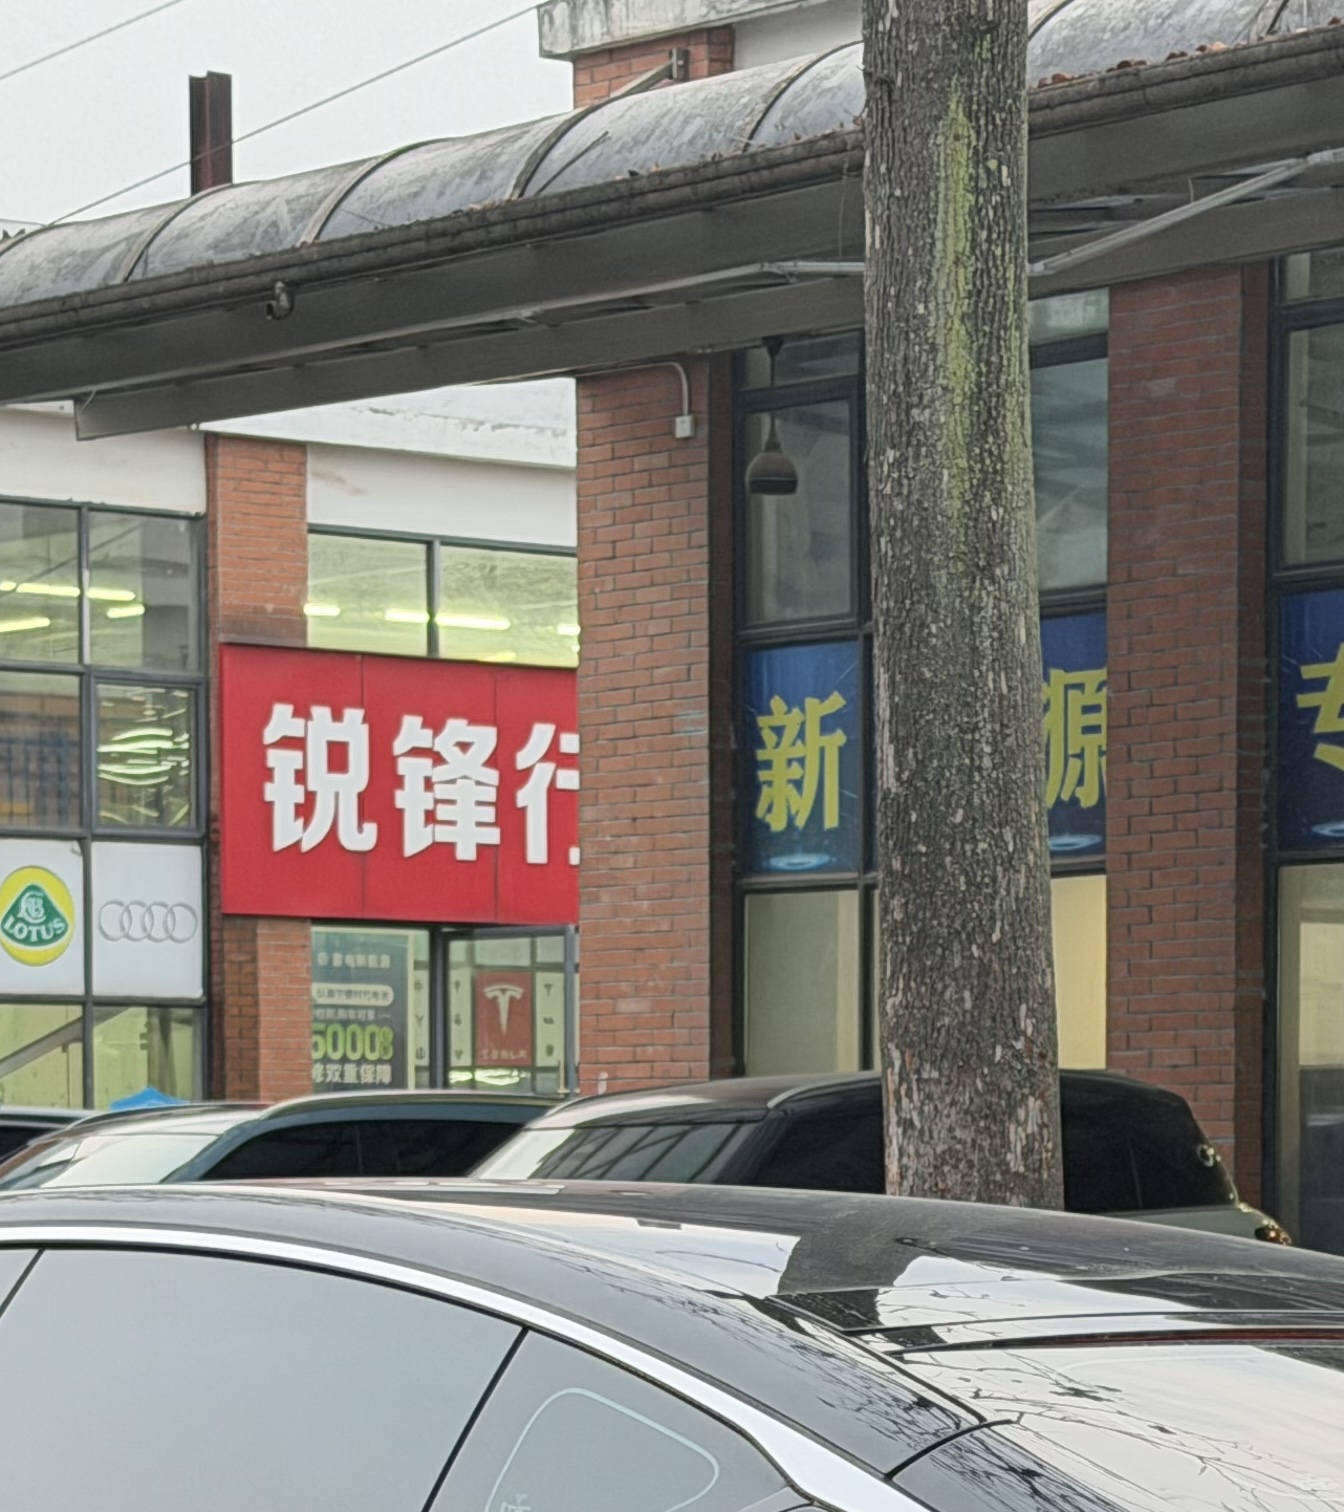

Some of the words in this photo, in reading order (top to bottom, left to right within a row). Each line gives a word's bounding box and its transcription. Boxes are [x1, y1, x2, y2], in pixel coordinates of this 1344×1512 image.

[263, 702, 580, 866] 锐锋行
[2, 914, 66, 942] LOTUS
